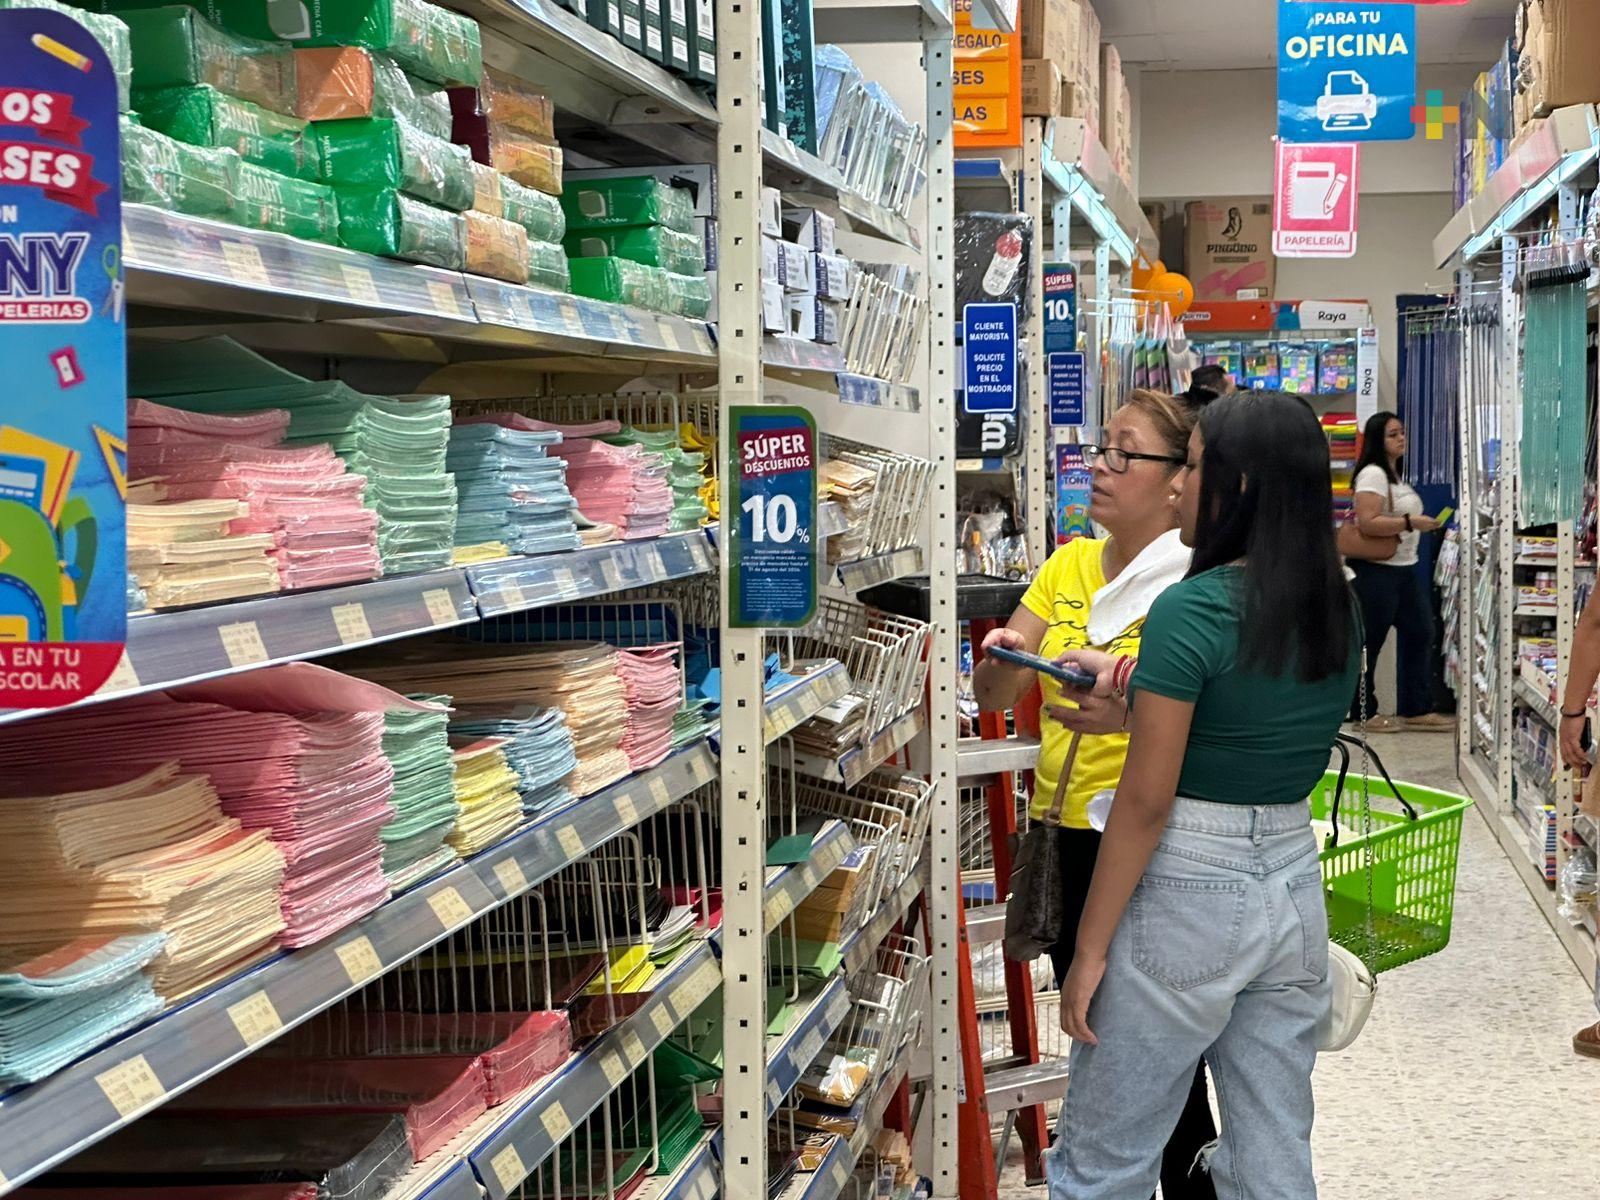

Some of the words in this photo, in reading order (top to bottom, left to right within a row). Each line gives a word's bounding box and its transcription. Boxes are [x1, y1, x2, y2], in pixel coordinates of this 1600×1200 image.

[1314, 12, 1357, 25] PARA
[1360, 11, 1381, 23] TU
[1285, 33, 1409, 59] OFICINA
[2, 92, 54, 124] OS
[1284, 233, 1345, 246] PAPELERÍA
[1045, 274, 1072, 286] SÚPER
[1318, 311, 1346, 323] Raya
[974, 322, 1004, 331] CLIENTE
[969, 332, 1009, 341] MAYORISTA
[974, 353, 1006, 362] SOLICITE
[976, 364, 1003, 372] PRECIO
[979, 374, 990, 383] EN
[990, 374, 1000, 383] EL
[1361, 368, 1374, 396] Raya
[968, 384, 1013, 393] MOSTRADOR
[743, 434, 806, 460] SÚPER
[745, 456, 810, 474] DESCUENTOS
[12, 648, 43, 666] EN
[49, 648, 80, 666] TU
